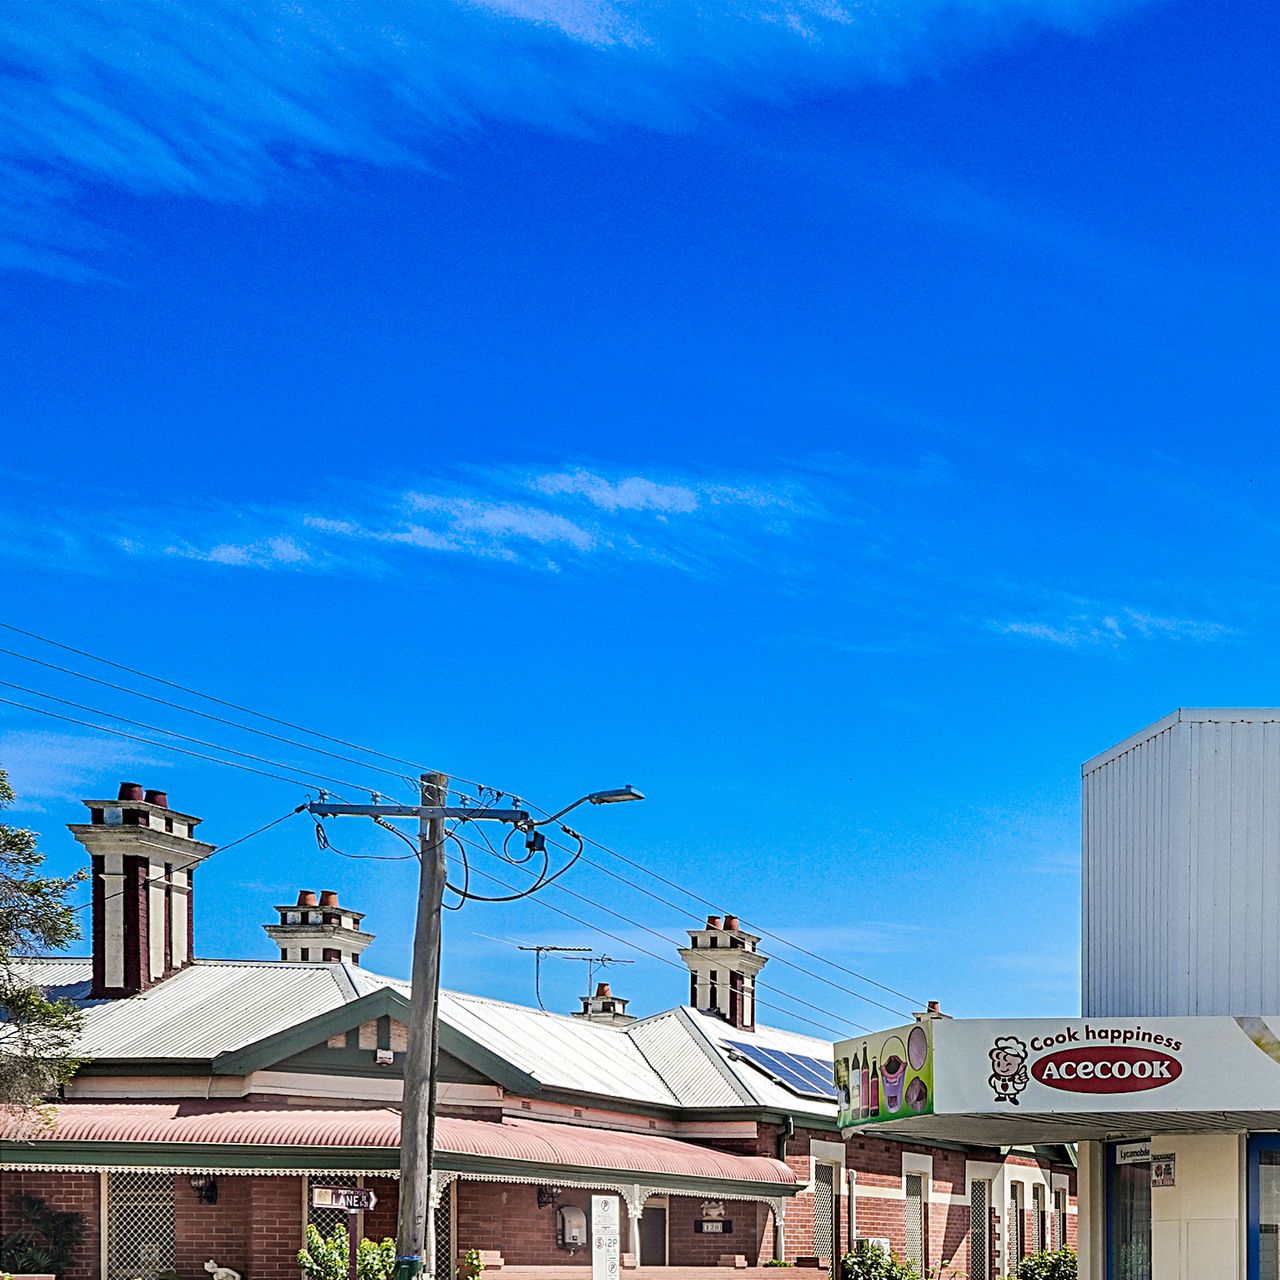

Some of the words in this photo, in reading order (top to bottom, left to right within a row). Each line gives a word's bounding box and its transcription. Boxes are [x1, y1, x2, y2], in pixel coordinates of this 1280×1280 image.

[1030, 1027, 1080, 1052] Cook
[1085, 1025, 1183, 1051] happiness
[332, 1194, 359, 1207] LANE
